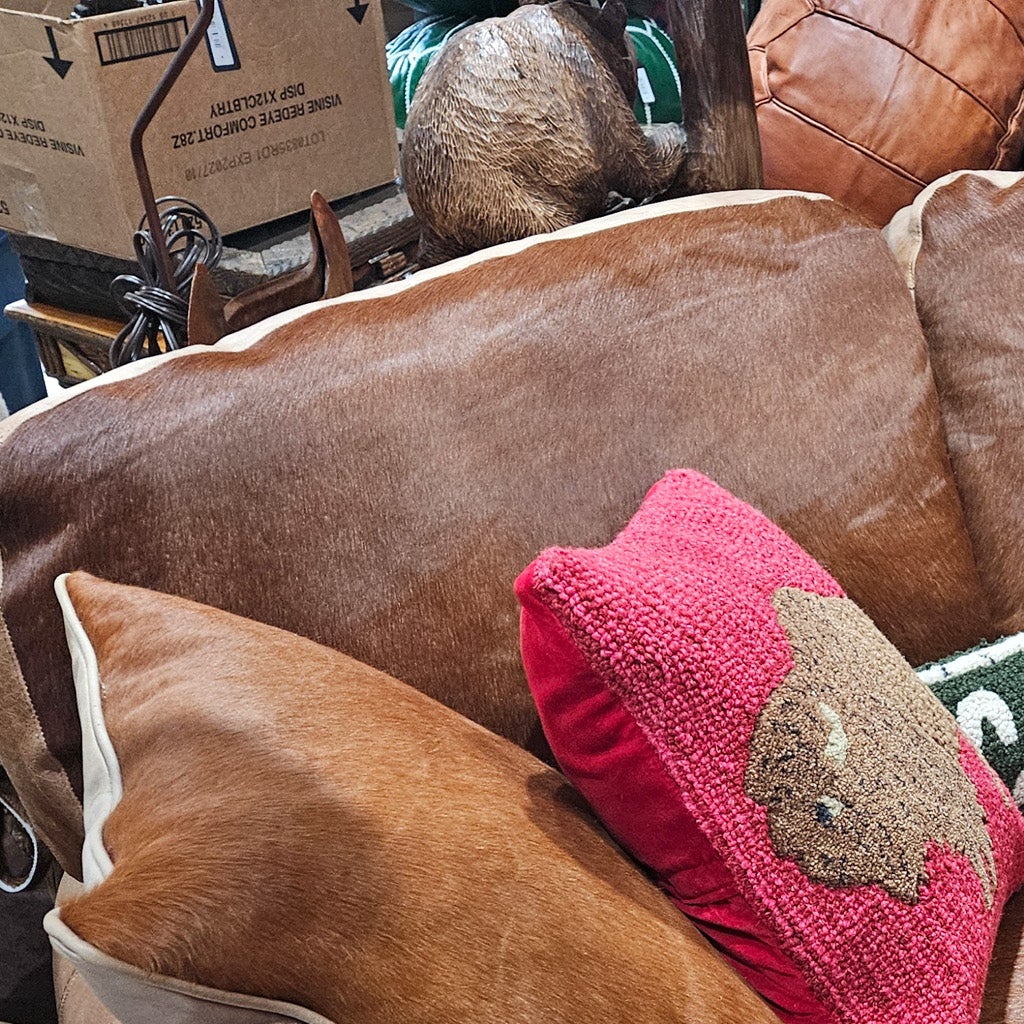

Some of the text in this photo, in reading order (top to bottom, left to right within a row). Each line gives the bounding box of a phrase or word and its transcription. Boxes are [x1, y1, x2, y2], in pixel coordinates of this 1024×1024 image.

[210, 82, 305, 119] DISP X12CLBTRY
[21, 118, 46, 132] DISP
[171, 94, 342, 149] VISINE REDEYE COMFORT.28Z
[4, 129, 48, 148] REDEYE
[49, 139, 85, 157] VISINE
